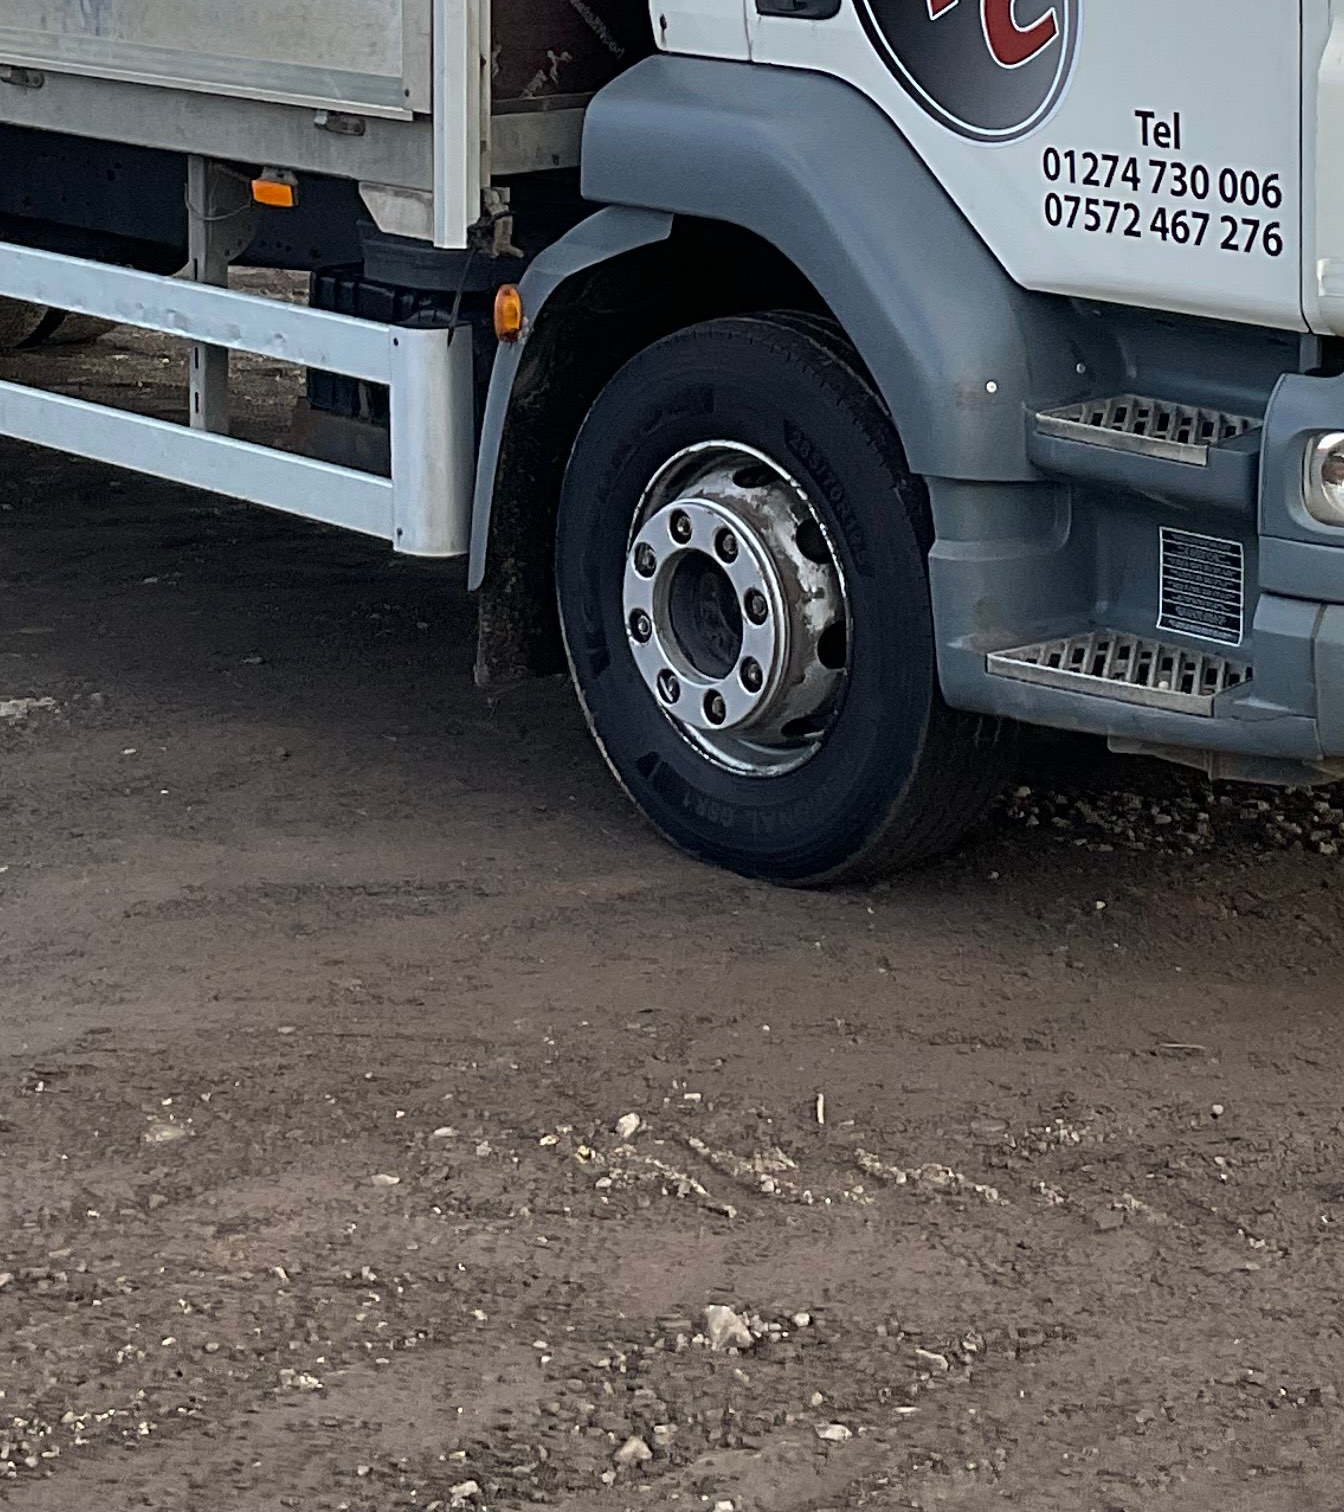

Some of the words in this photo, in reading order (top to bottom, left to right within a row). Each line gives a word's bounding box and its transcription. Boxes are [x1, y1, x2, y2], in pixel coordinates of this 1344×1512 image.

[1134, 109, 1181, 150] Tel
[1042, 147, 1141, 192] 01274
[1148, 158, 1209, 200] 730
[1218, 167, 1283, 209] 006
[1044, 192, 1142, 239] 07572
[1149, 205, 1209, 247] 467
[1219, 214, 1284, 257] 276
